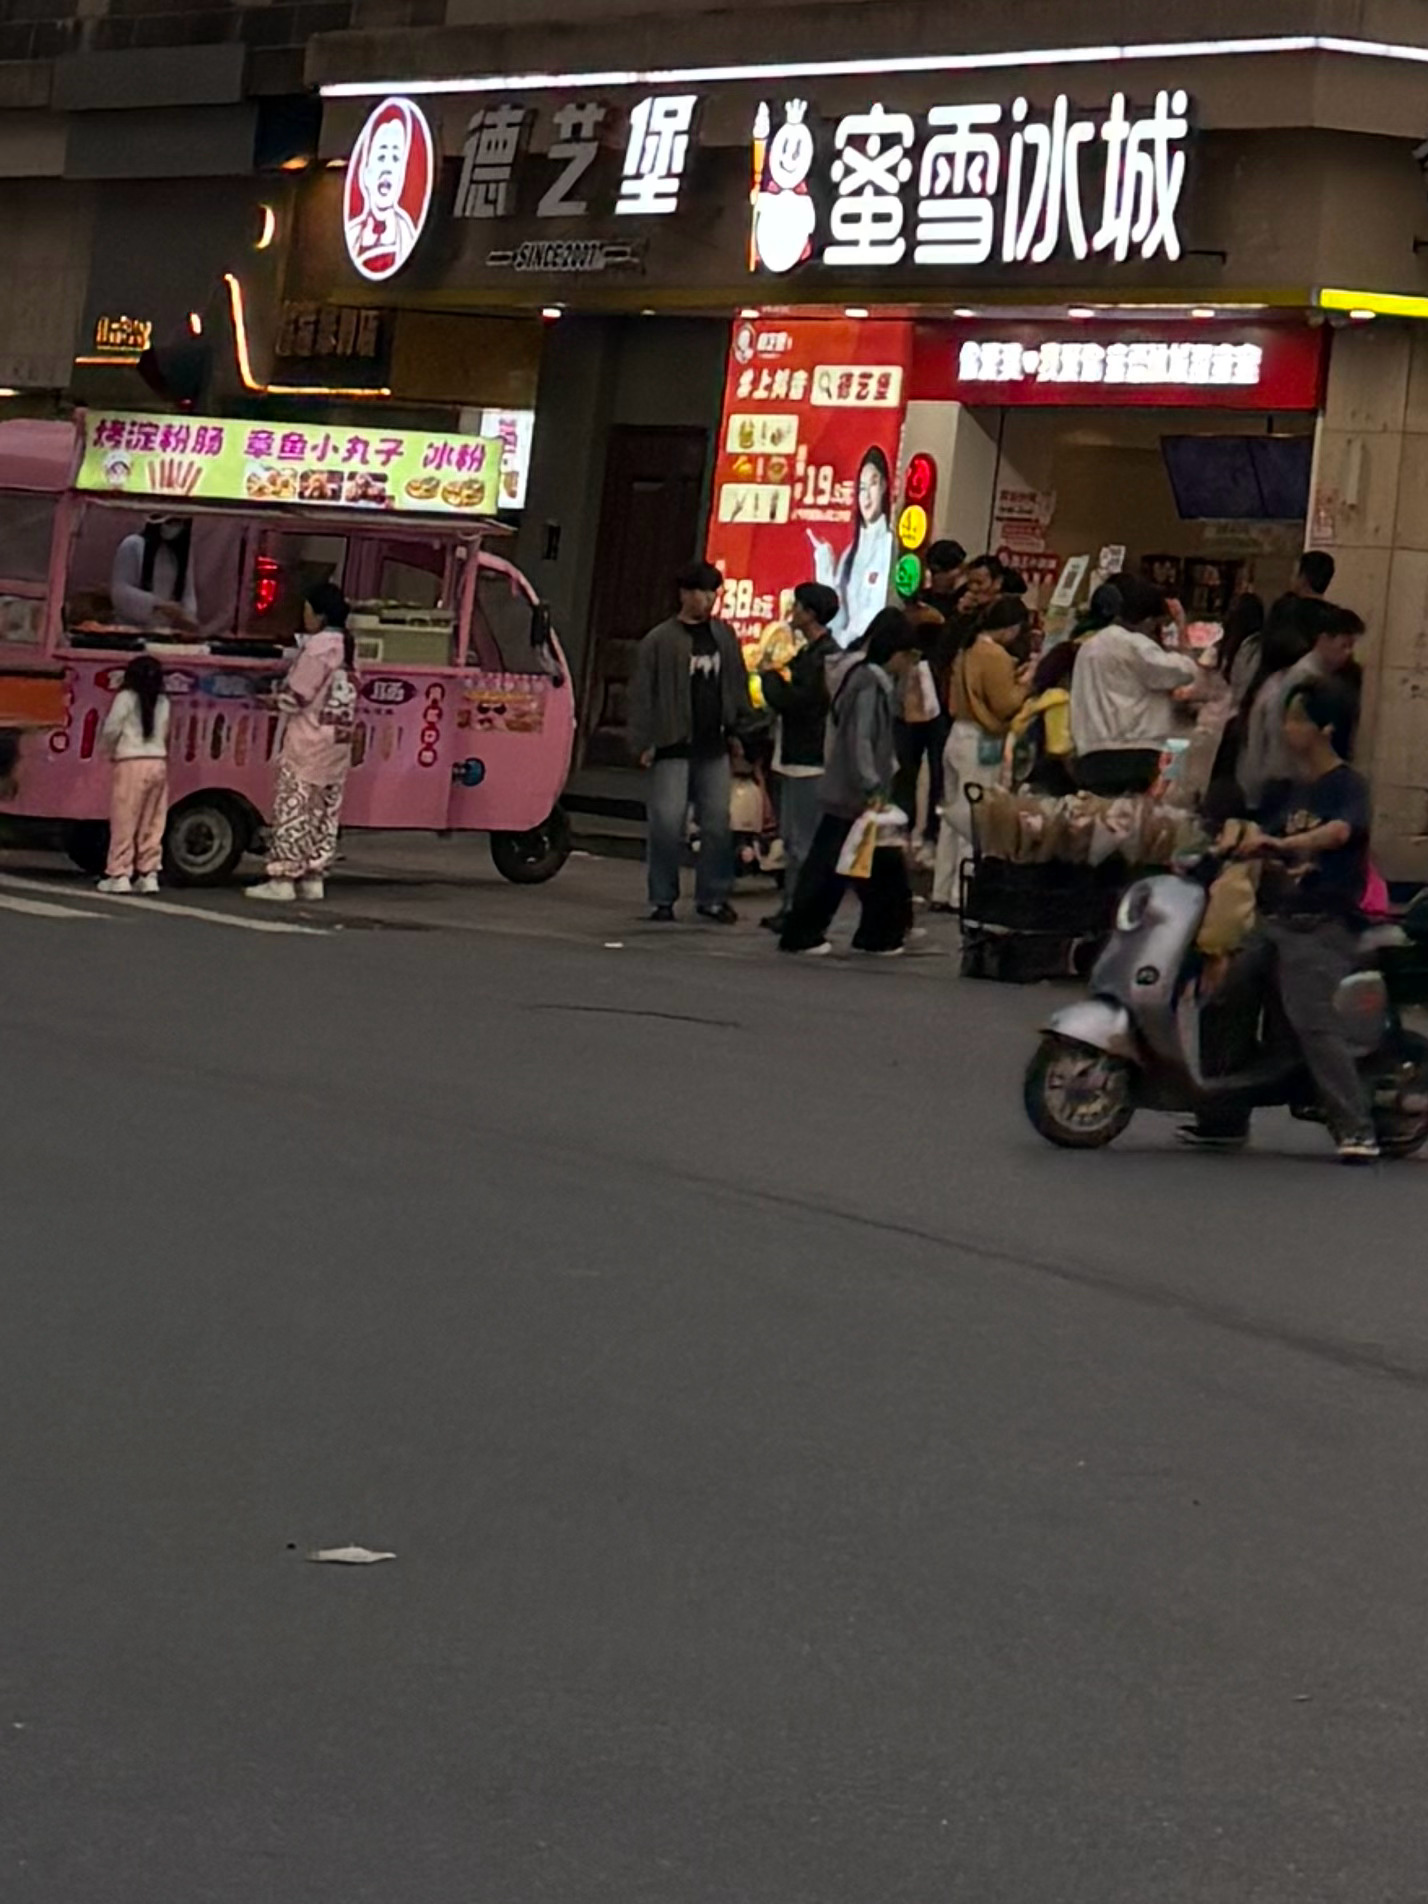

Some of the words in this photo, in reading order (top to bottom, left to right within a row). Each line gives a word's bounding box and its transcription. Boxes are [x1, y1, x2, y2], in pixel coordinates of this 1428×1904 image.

[453, 94, 699, 219] 德艺堡
[823, 89, 1188, 266] 蜜雪冰城
[93, 419, 225, 456] 烤淀粉肠
[244, 429, 405, 467] 章鱼小丸子
[421, 440, 488, 473] 冰粉
